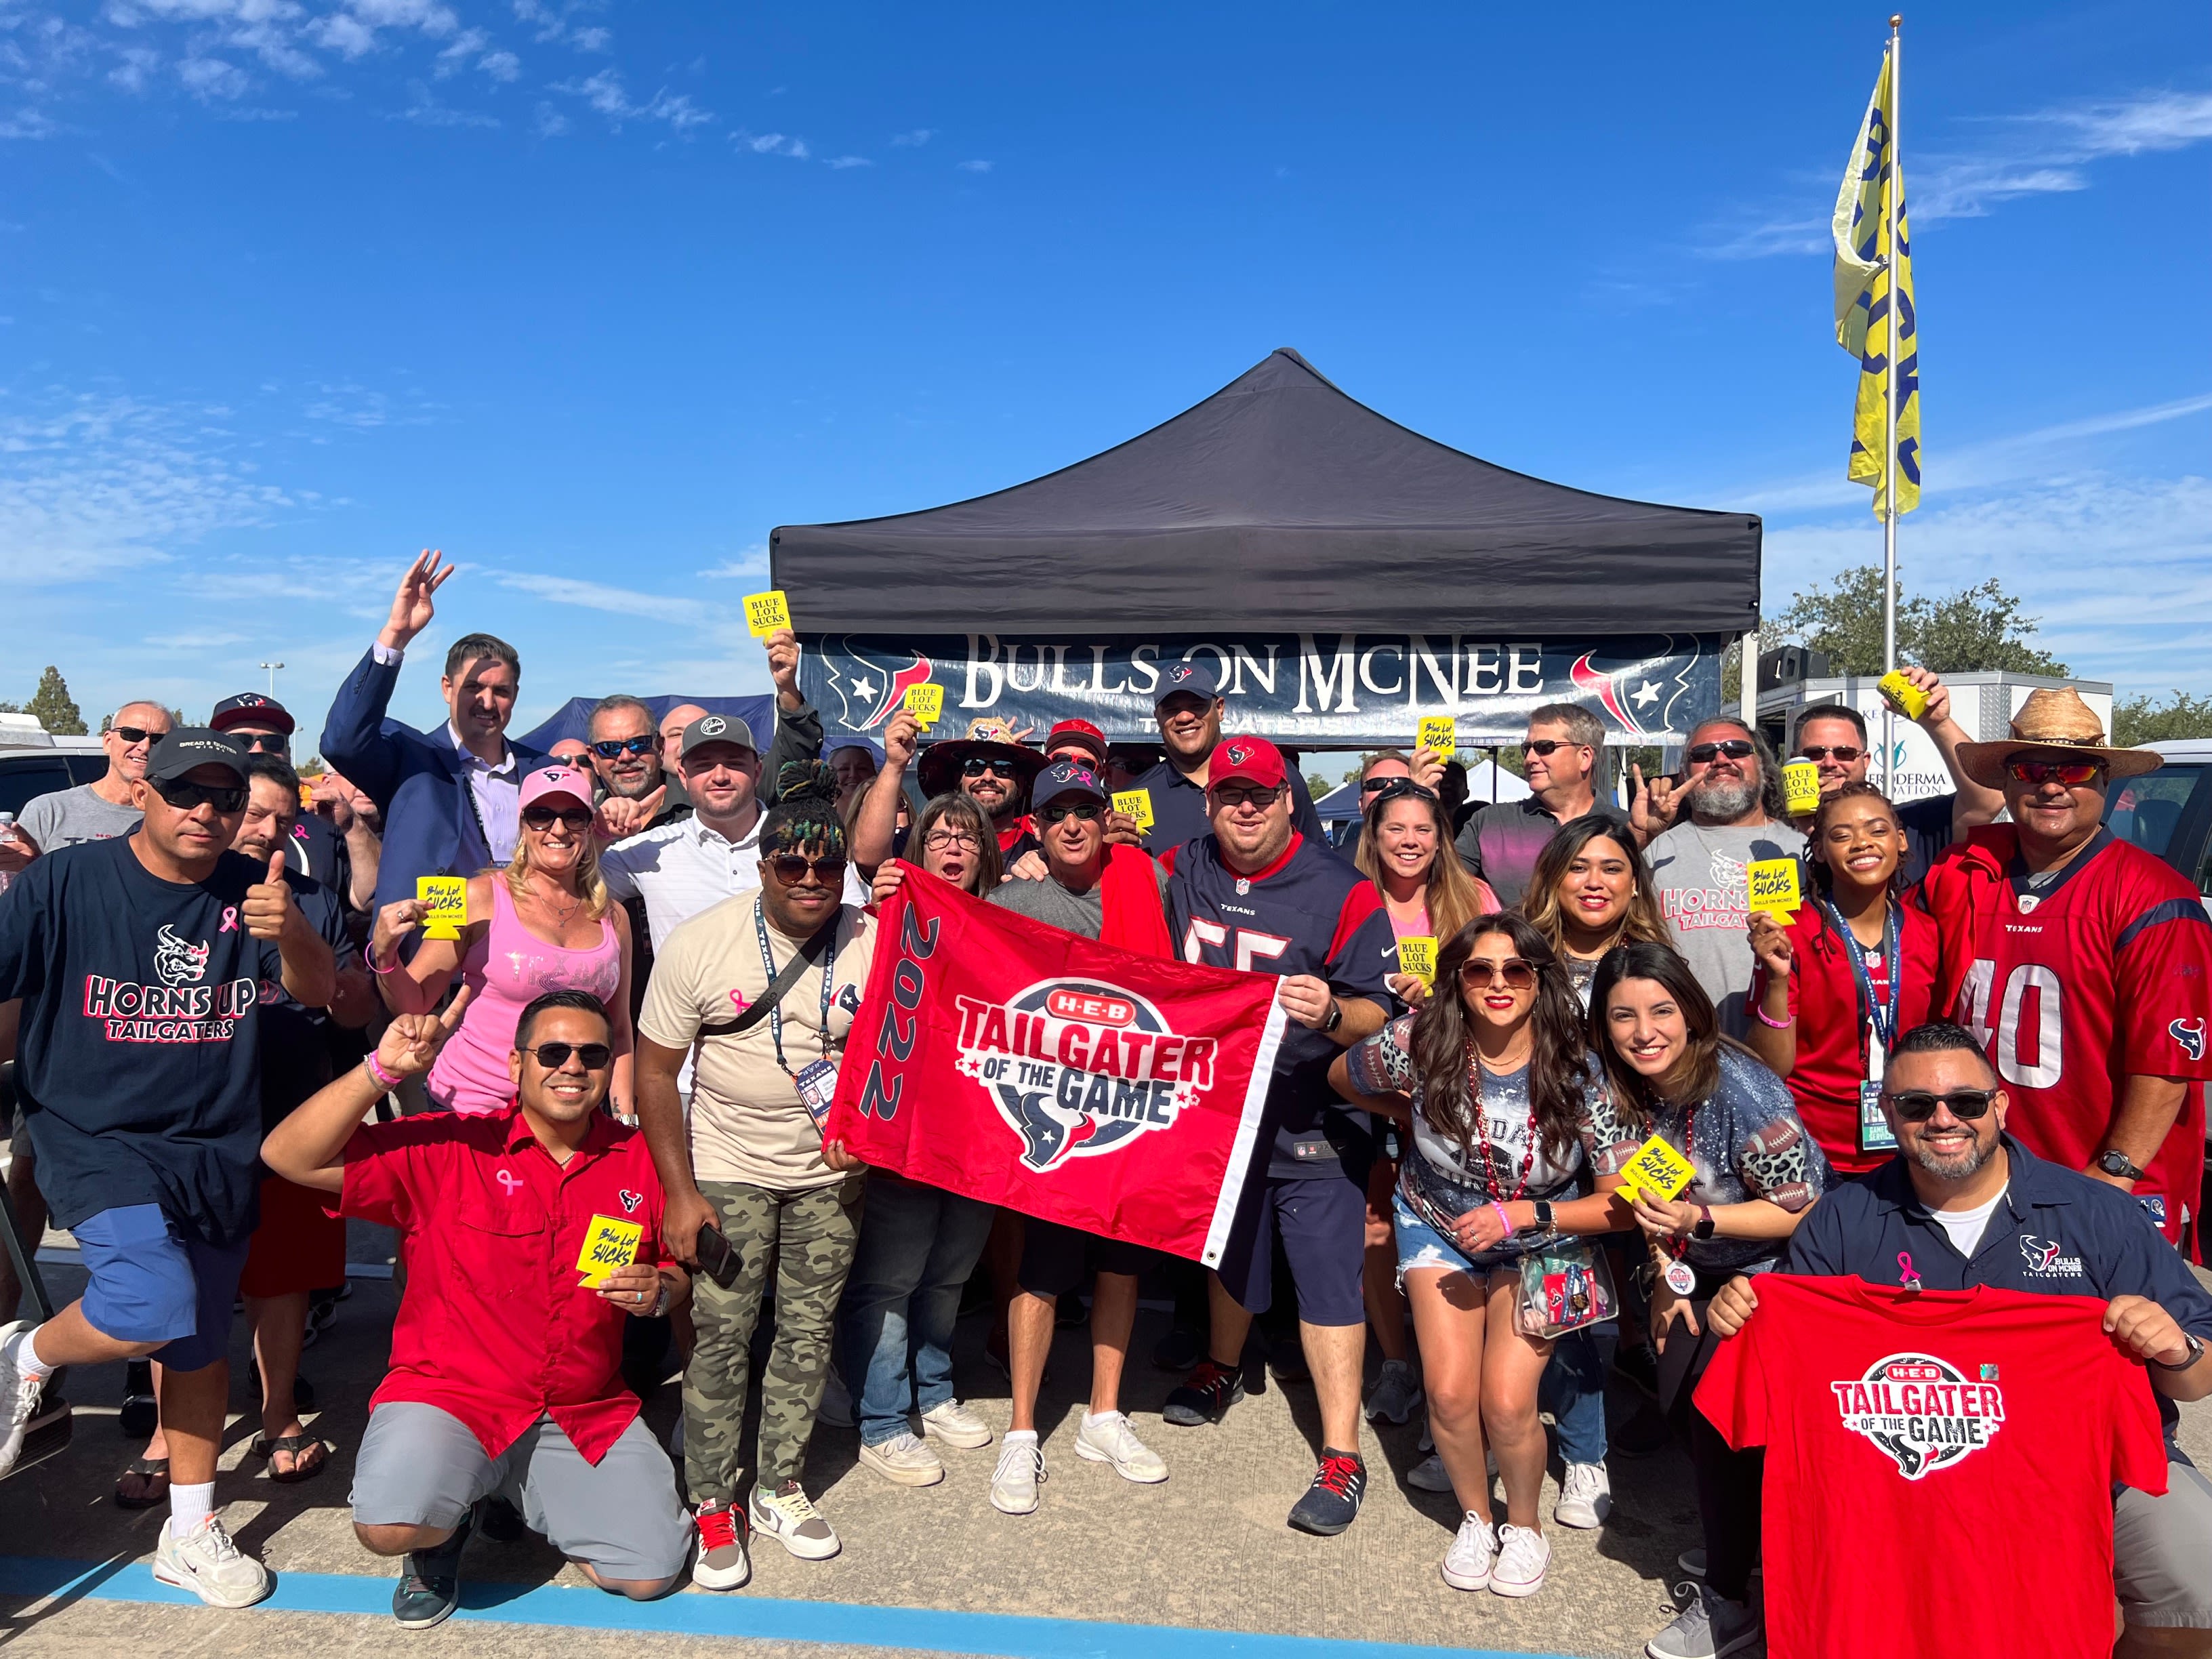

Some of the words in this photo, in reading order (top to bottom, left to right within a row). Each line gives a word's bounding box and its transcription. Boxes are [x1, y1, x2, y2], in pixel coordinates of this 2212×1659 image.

[751, 598, 780, 609] BLUE
[756, 606, 777, 617] LOT
[753, 614, 785, 626] SUCKS
[958, 634, 1160, 708] BULLS
[1181, 643, 1280, 695] ON
[911, 689, 937, 697] BLUE
[912, 695, 932, 703] LOT
[907, 703, 937, 712] SUCKS
[1425, 722, 1441, 733] Blue
[1441, 722, 1452, 733] Lot
[1424, 733, 1452, 747] SUCKS
[213, 741, 237, 755] BUTTER
[1783, 769, 1812, 781] BLUE
[1785, 778, 1809, 790] LOT
[1118, 796, 1142, 806] BLUE
[1121, 804, 1140, 813] LOT
[1753, 869, 1771, 882] Blue
[1773, 866, 1787, 879] Lot
[426, 884, 444, 896] Blue
[447, 885, 460, 895] Lot
[1753, 878, 1792, 895] SUCKS
[1221, 903, 1256, 916] TEXANS
[2005, 924, 2043, 933] TEXANS
[758, 930, 773, 975] TEXANS
[1401, 943, 1428, 953] BLUE
[1849, 936, 1862, 962] TEXANS
[1406, 953, 1425, 962] LOT
[823, 951, 834, 994] TEXANS
[1403, 962, 1432, 973] SUCKS
[1865, 976, 1876, 1002] TEXANS
[83, 974, 212, 1019] HORNS
[217, 977, 256, 1019] UP
[859, 900, 941, 1121] 2022
[1056, 996, 1127, 1020] H-E-B
[1958, 958, 2062, 1089] 40
[105, 1019, 234, 1043] TAILGATERS
[957, 996, 1215, 1088] TAILGATER
[798, 1065, 832, 1088] TEXANS
[983, 1057, 1010, 1080] OF
[1018, 1062, 1055, 1088] THE
[1056, 1067, 1176, 1124] GAME
[1647, 1147, 1667, 1165] Blue
[1665, 1162, 1684, 1176] Lot
[1630, 1168, 1643, 1181] BULLS
[1637, 1157, 1676, 1189] SUCKS
[597, 1227, 620, 1244] Blue
[620, 1233, 638, 1247] Lot
[590, 1243, 632, 1267] SUCKS
[2047, 1265, 2057, 1273] ON
[1891, 1368, 1937, 1378] H-E-B
[1833, 1383, 2004, 1418] TAILGATER
[1861, 1418, 1875, 1431] OF
[1880, 1418, 1906, 1431] THE
[1908, 1417, 1984, 1444] GAME
